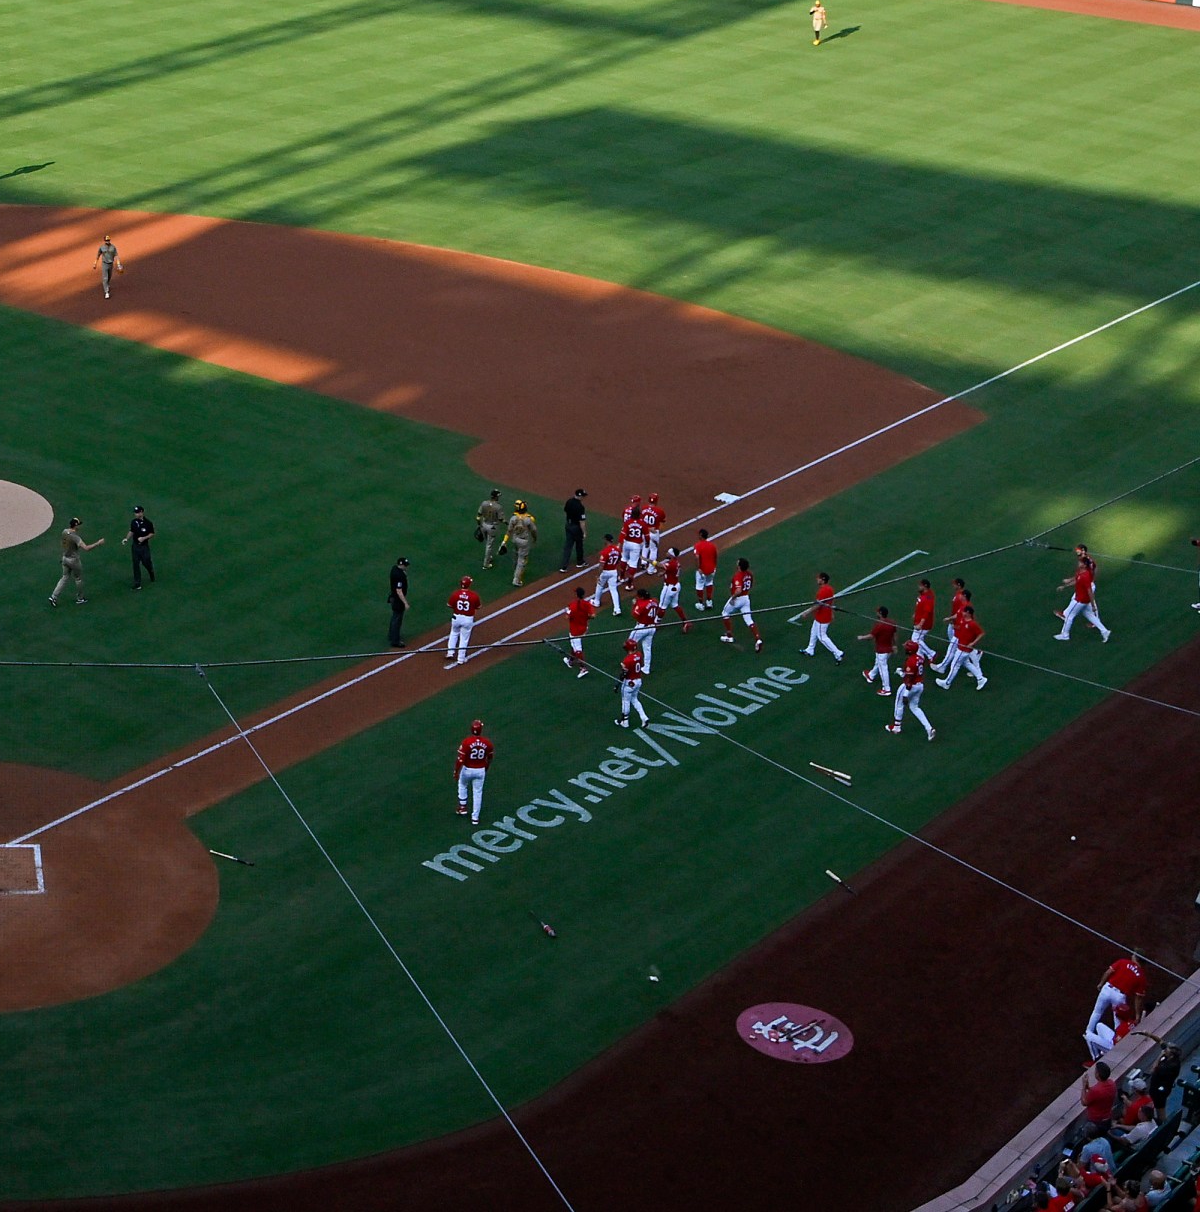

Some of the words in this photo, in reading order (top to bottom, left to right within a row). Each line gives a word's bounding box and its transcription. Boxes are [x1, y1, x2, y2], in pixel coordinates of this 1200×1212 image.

[628, 528, 642, 538] 33
[608, 556, 618, 566] 37
[456, 600, 470, 611] 63
[470, 748, 486, 760] 28
[422, 666, 810, 882] mercy.net/NoLine
